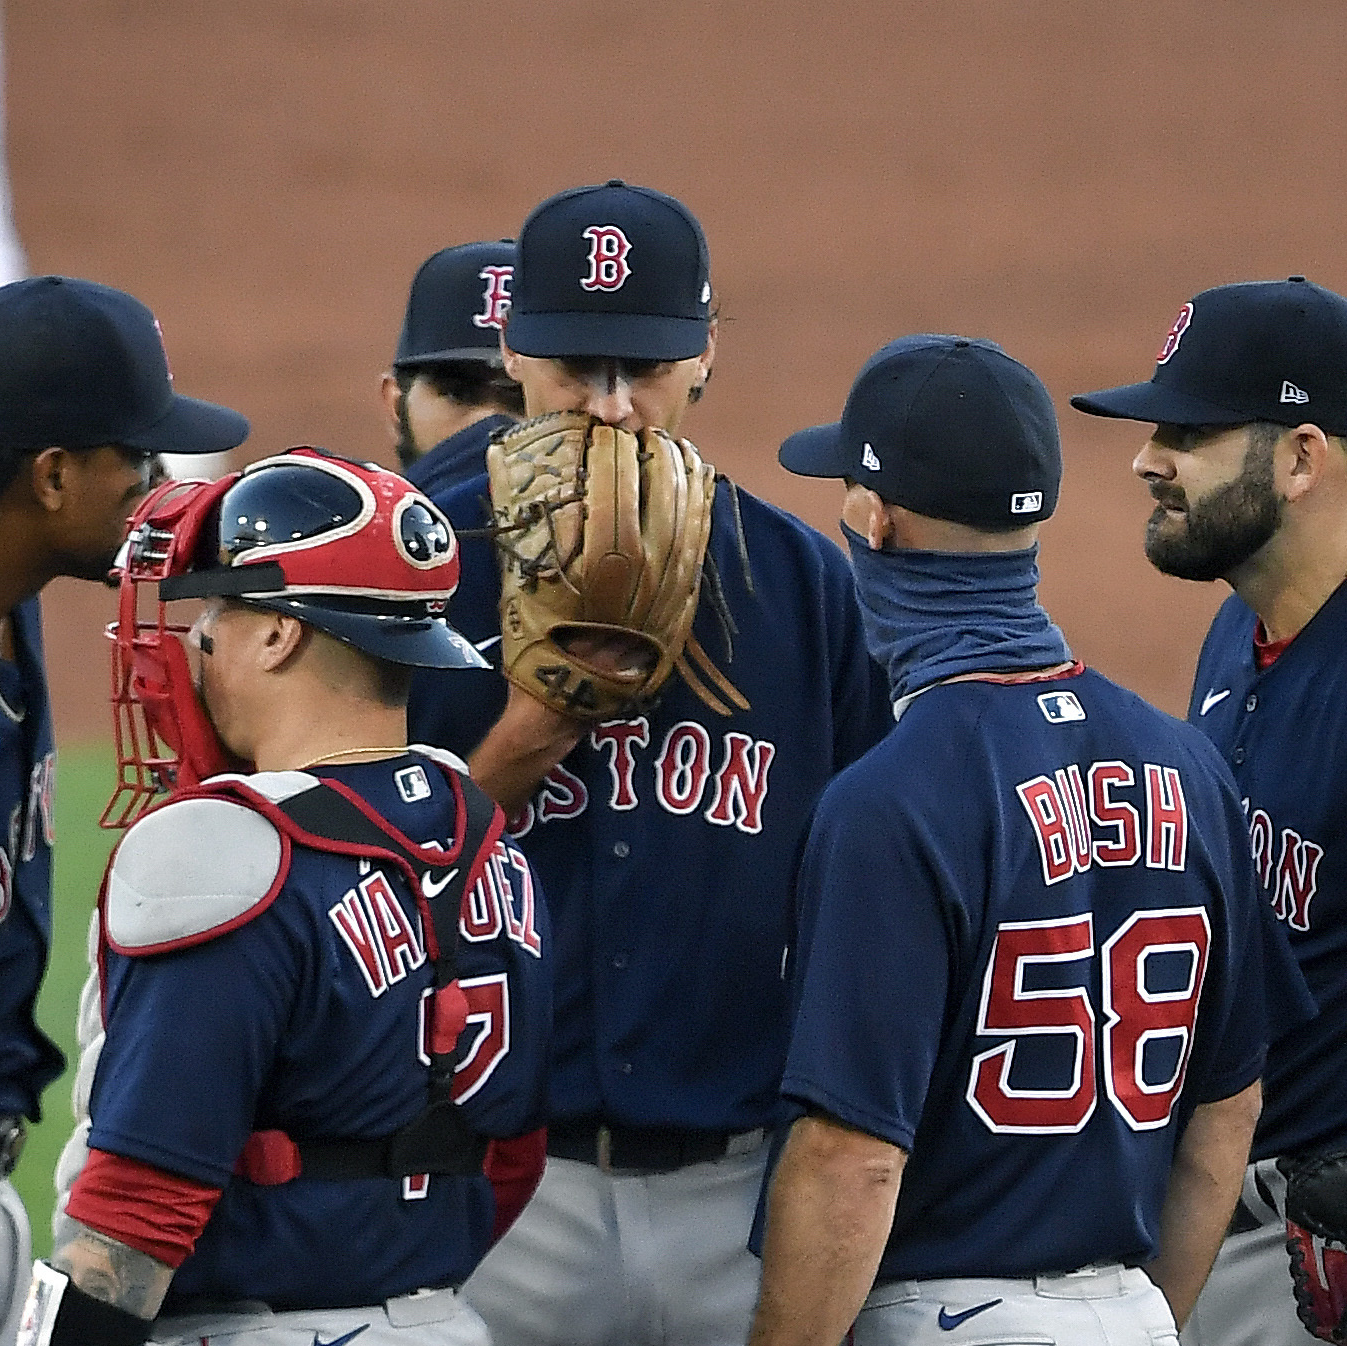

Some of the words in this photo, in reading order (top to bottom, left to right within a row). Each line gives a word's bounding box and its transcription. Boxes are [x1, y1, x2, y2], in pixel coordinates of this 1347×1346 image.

[580, 225, 632, 292] B
[1015, 760, 1189, 886] BUSH
[965, 905, 1213, 1134] 58
